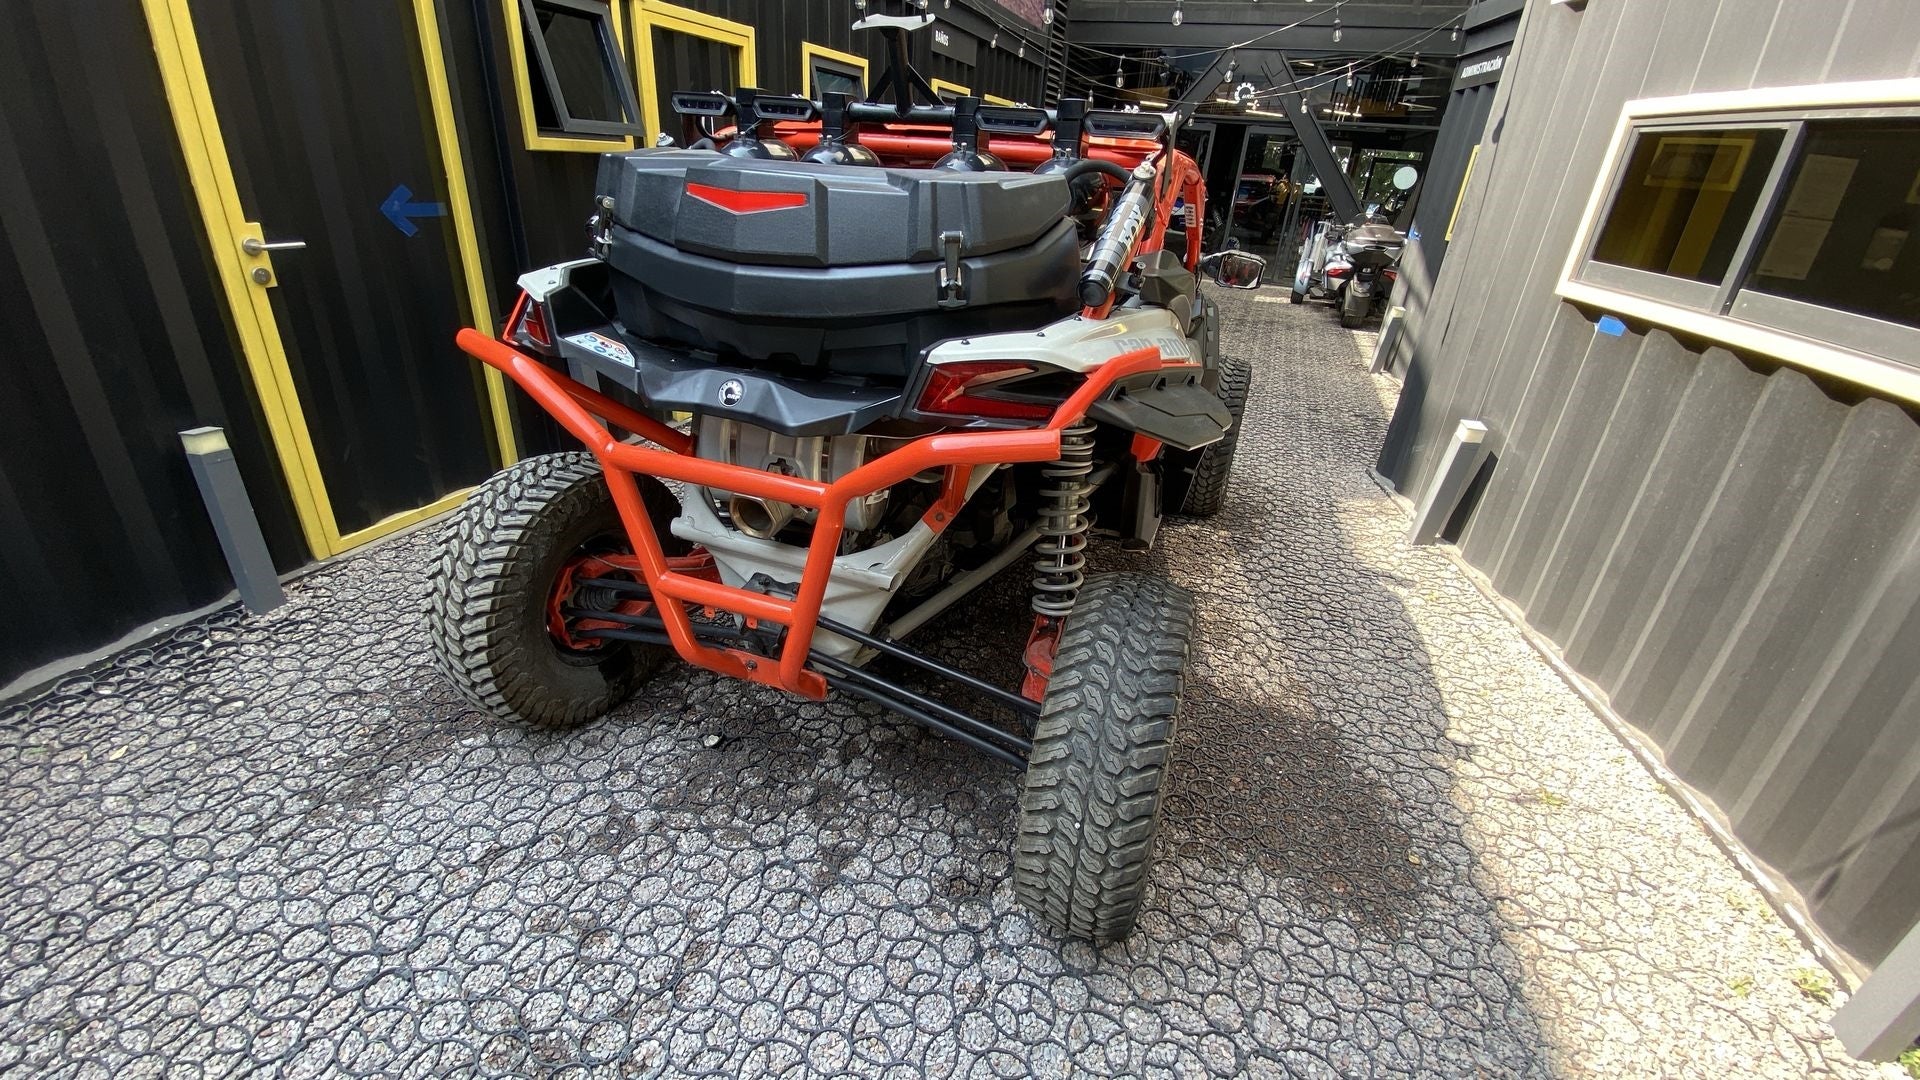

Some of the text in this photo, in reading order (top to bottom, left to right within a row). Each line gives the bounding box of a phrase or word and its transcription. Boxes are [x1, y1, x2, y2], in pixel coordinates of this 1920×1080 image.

[935, 29, 949, 47] BAÑOS
[1460, 55, 1503, 79] ADMINISTRACIÓN
[1117, 203, 1145, 253] FOX
